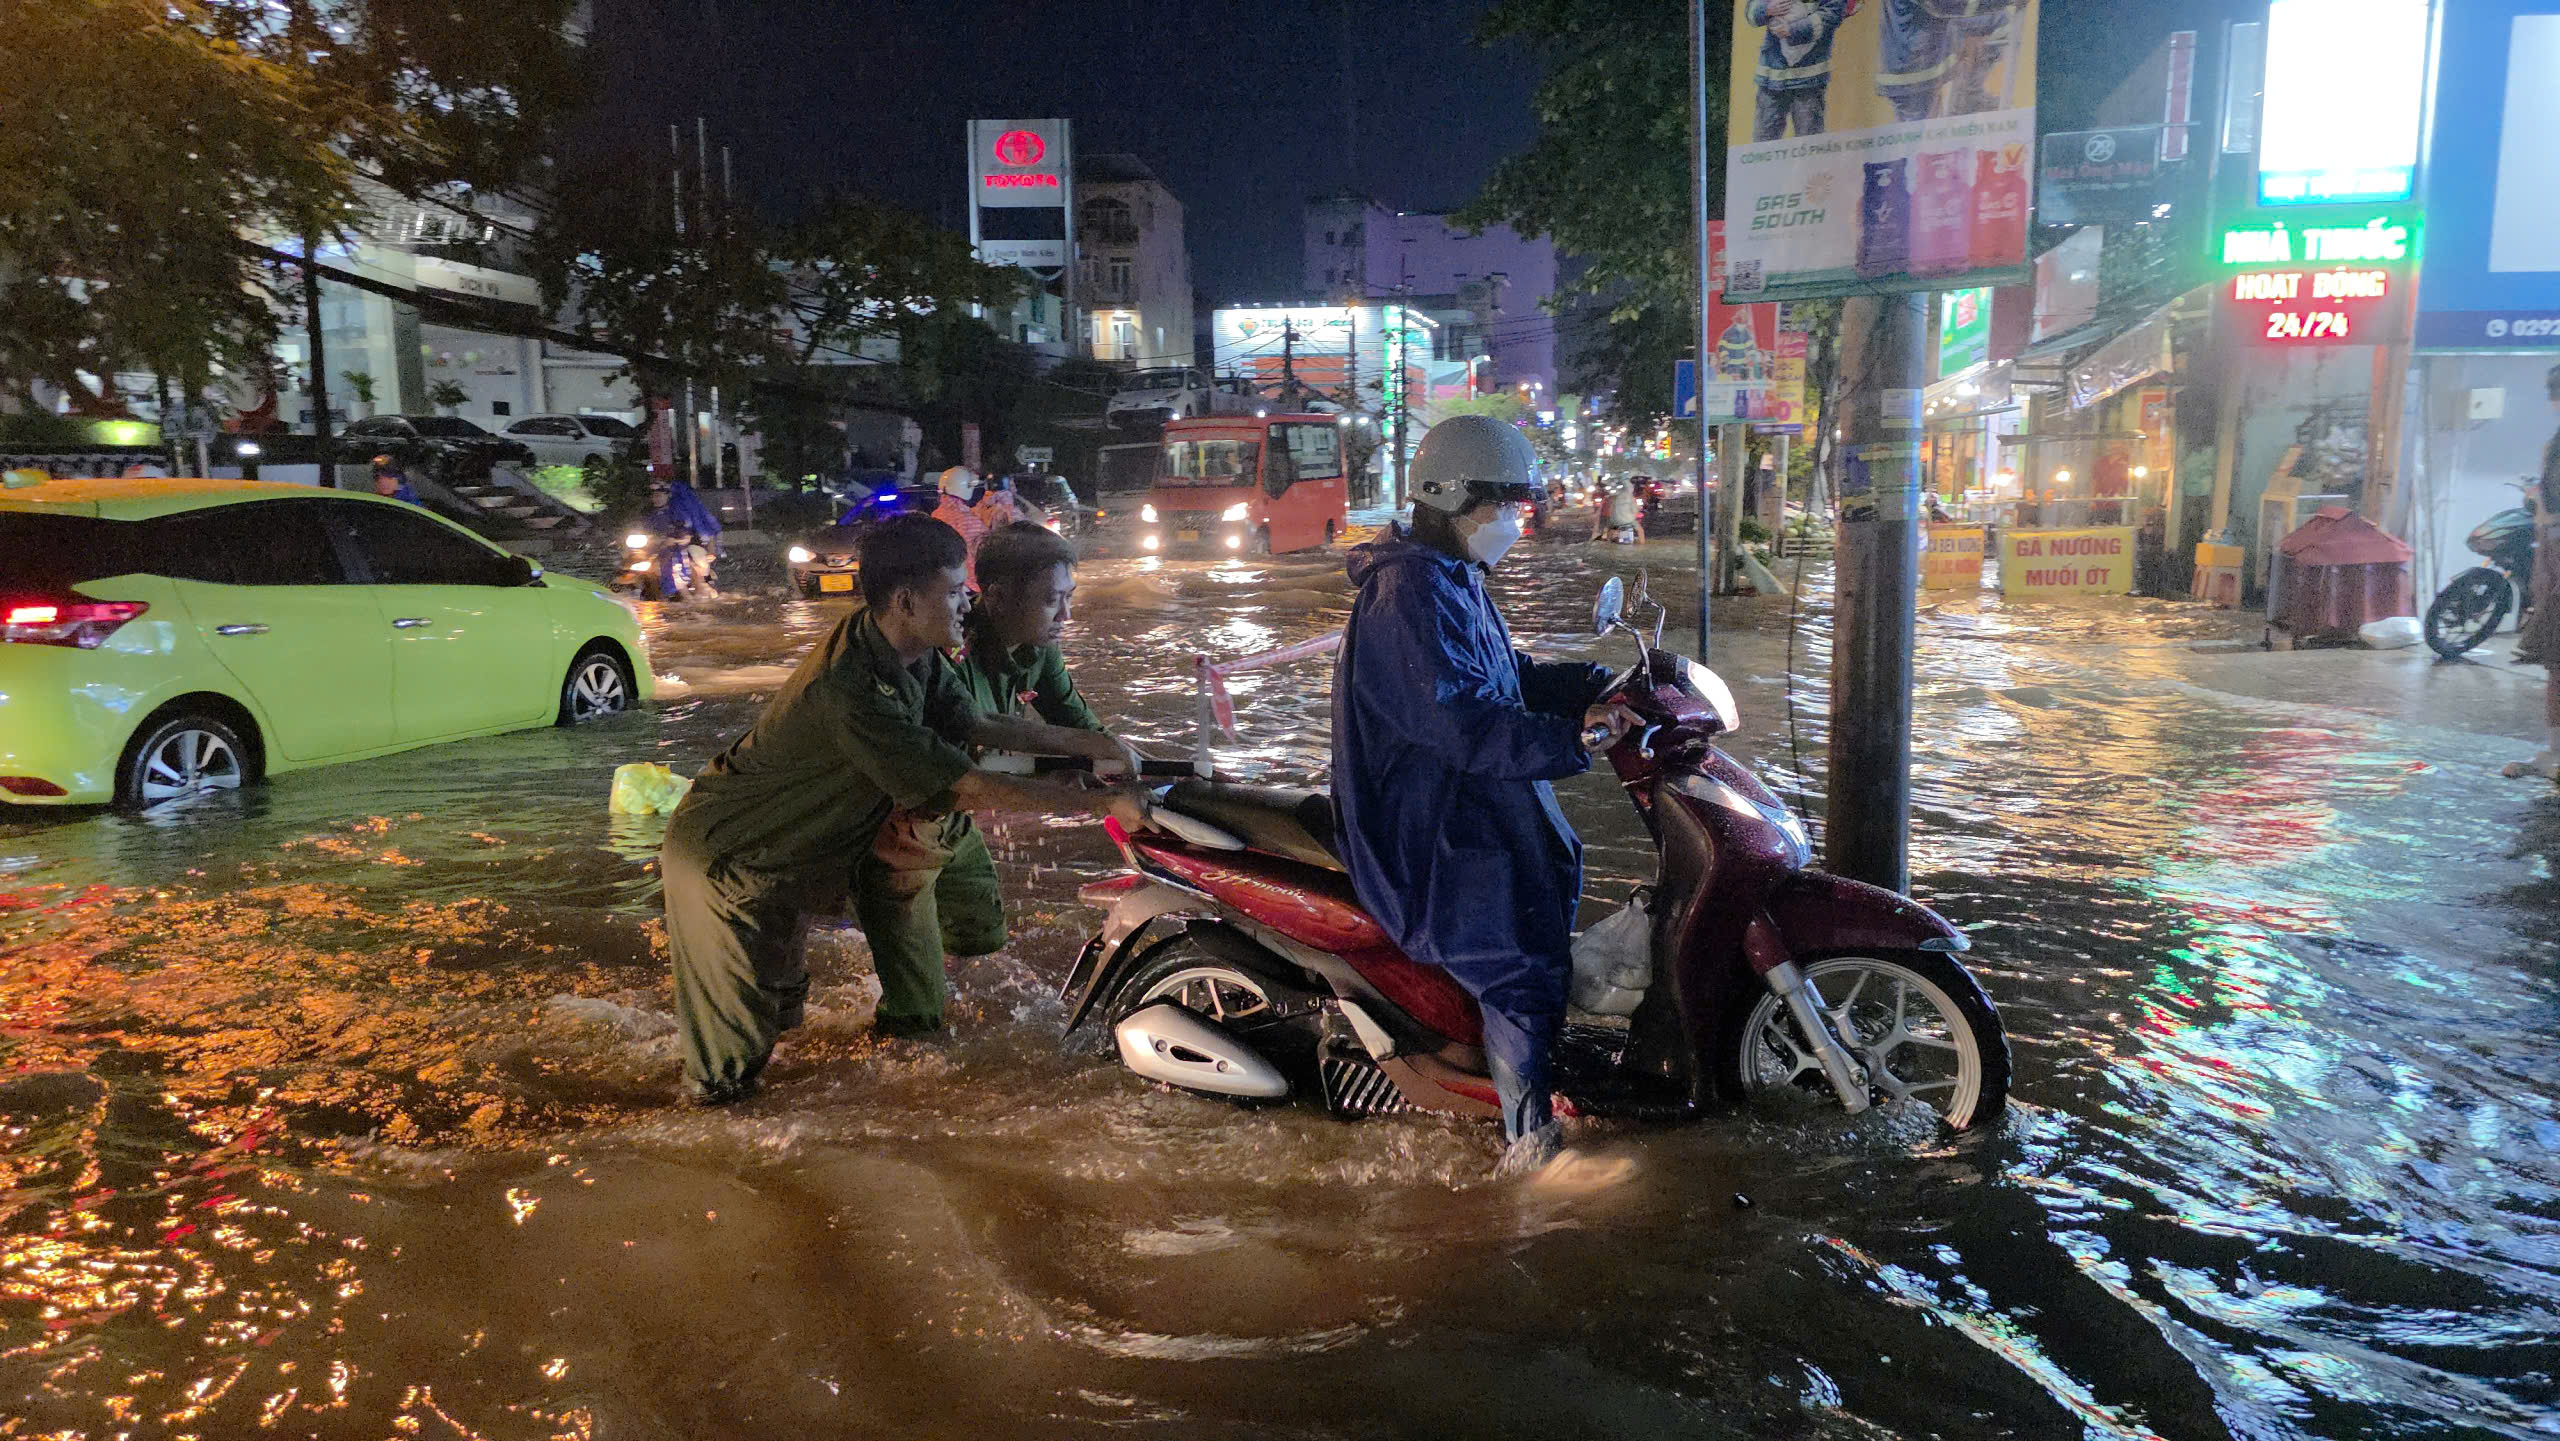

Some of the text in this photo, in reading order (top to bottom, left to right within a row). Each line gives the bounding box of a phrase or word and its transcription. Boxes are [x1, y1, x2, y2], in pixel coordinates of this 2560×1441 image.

[984, 173, 1058, 188] TOYOTA
[1755, 192, 1802, 212] GAS
[1751, 208, 1826, 231] SOUTH
[2224, 217, 2407, 264] NHÀ THUỐC
[2235, 265, 2386, 304] HOẠT ĐỘNG
[2267, 311, 2348, 338] 24/24
[2512, 319, 2560, 336] 0292
[2050, 535, 2122, 556] NƯỚNG
[2026, 563, 2111, 586] MUỐI ỚT
